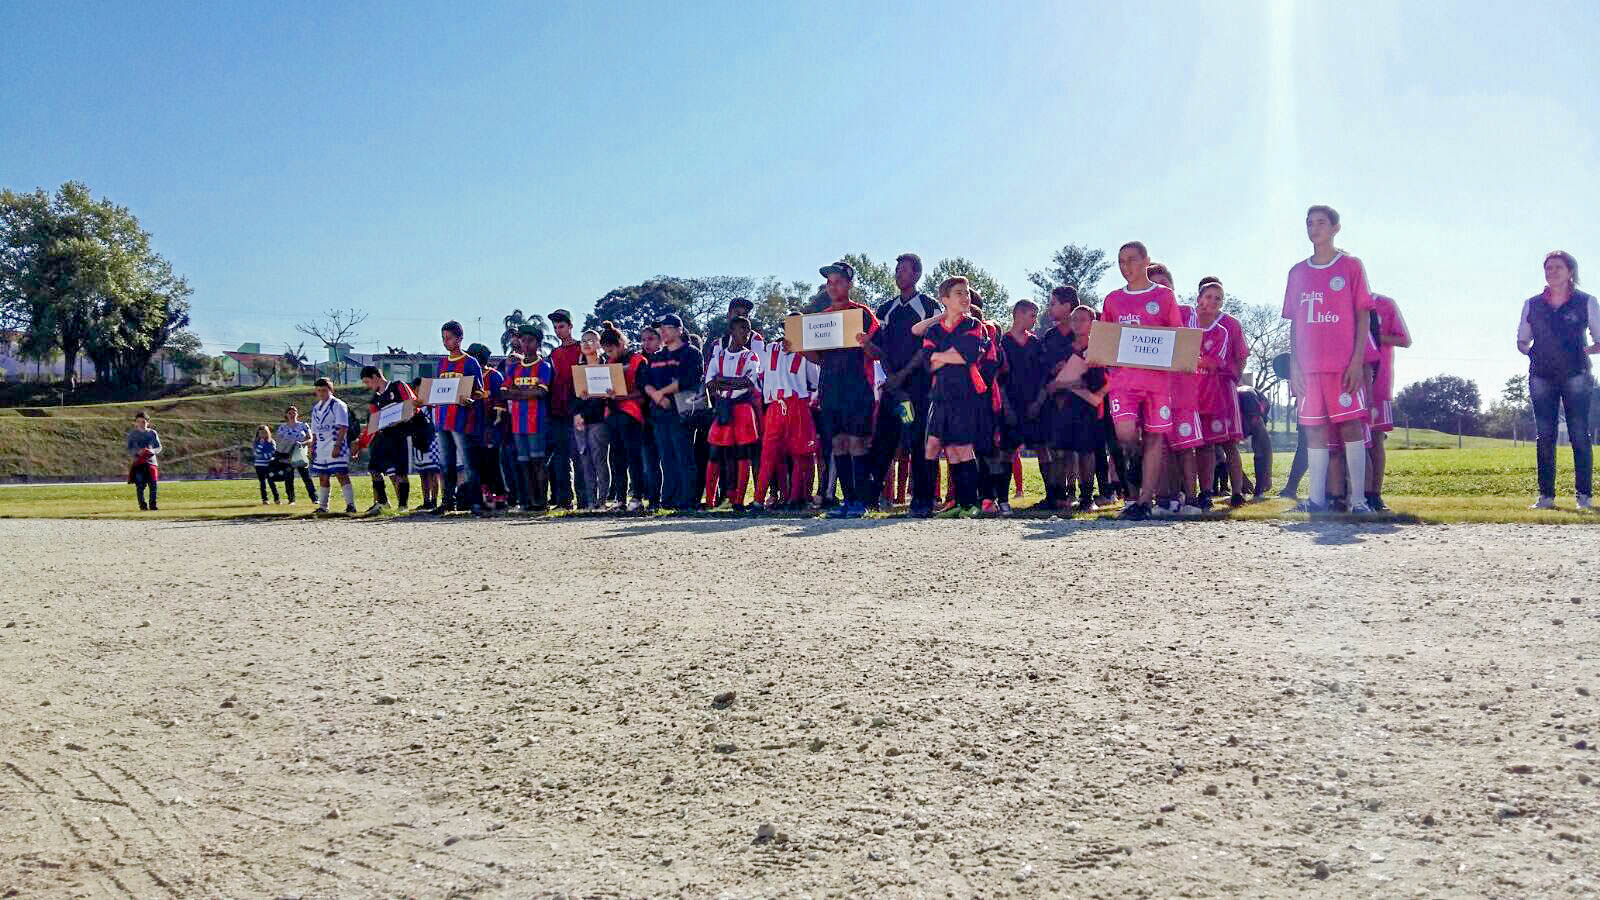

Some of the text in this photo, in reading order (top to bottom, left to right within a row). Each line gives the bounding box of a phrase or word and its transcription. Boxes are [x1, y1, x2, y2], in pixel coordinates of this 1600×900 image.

[808, 320, 837, 330] Leonardo
[1131, 335, 1164, 344] PADRE
[1111, 398, 1121, 412] 6
